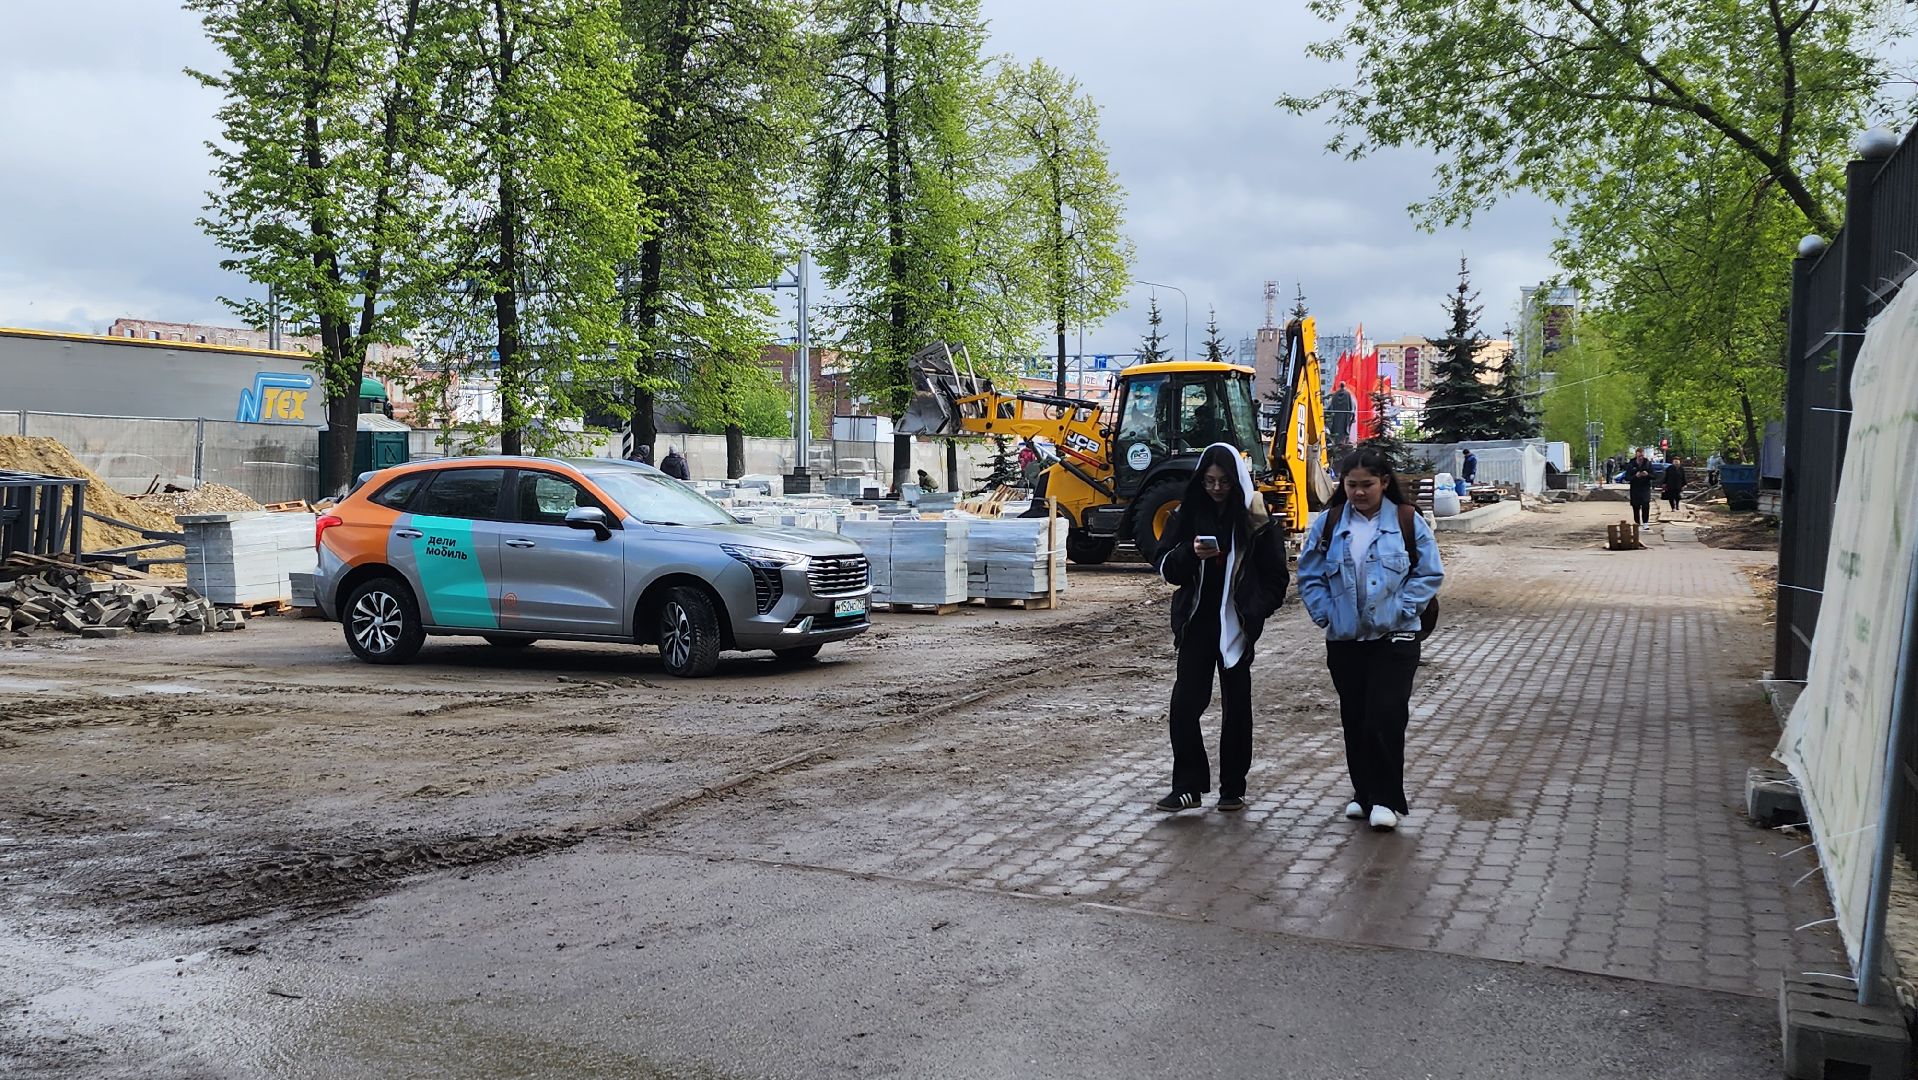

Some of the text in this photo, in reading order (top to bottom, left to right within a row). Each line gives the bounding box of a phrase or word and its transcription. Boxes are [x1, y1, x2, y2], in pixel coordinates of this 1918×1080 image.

[1298, 403, 1306, 461] JCB
[1067, 431, 1100, 452] JCB
[428, 536, 456, 547] дели
[426, 546, 468, 560] мобиль
